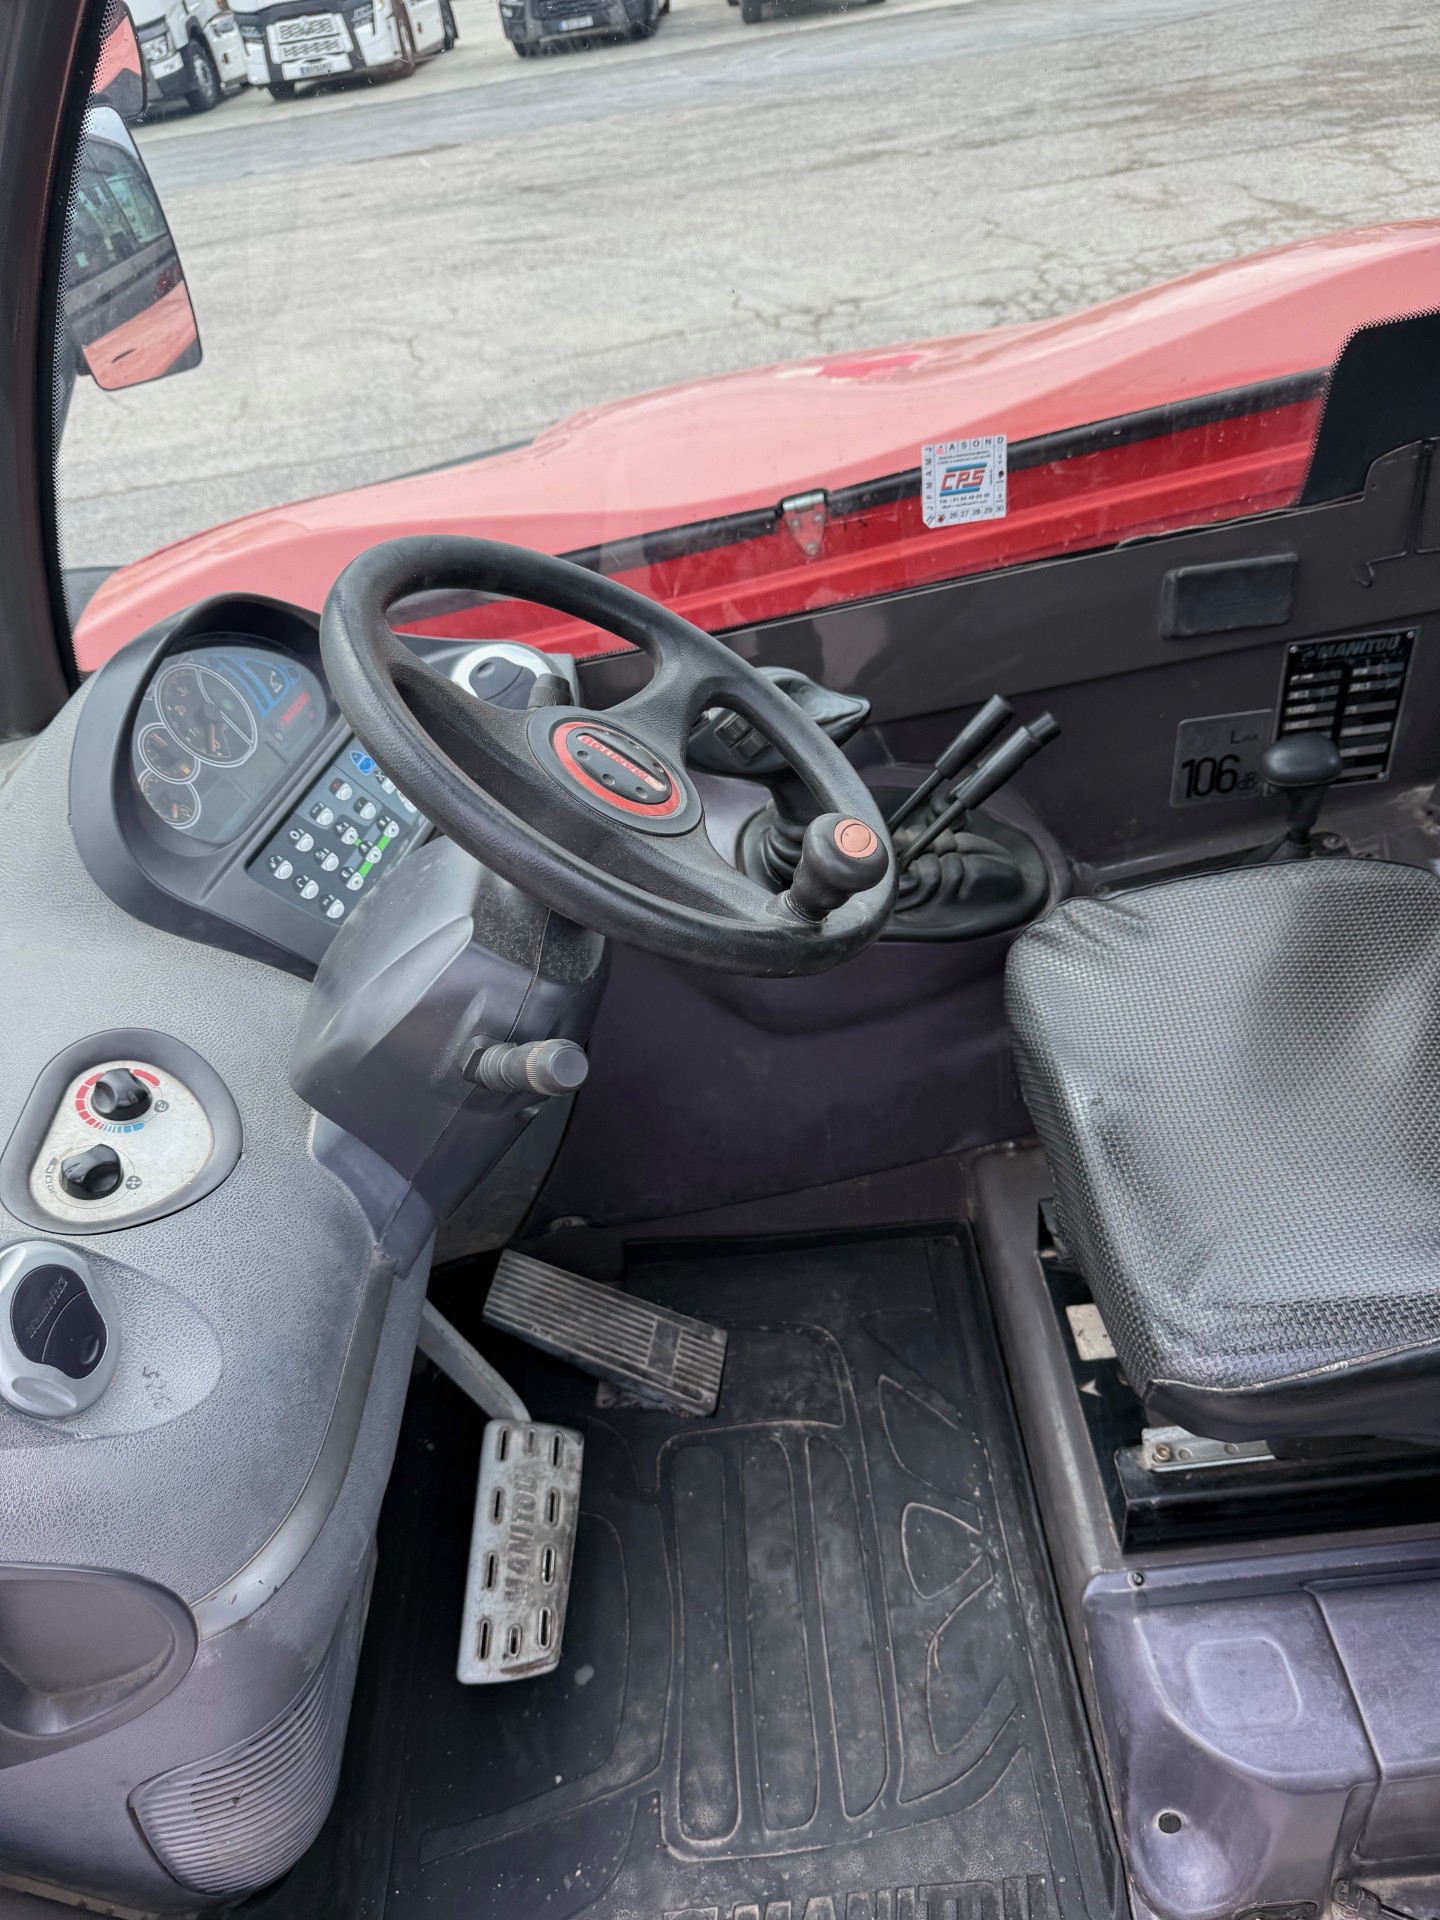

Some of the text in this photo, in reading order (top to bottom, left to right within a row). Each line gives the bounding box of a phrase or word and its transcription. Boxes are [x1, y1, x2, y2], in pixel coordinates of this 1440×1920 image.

[940, 467, 985, 491] CPS
[1320, 635, 1401, 659] MANITOU
[1182, 753, 1240, 799] 106
